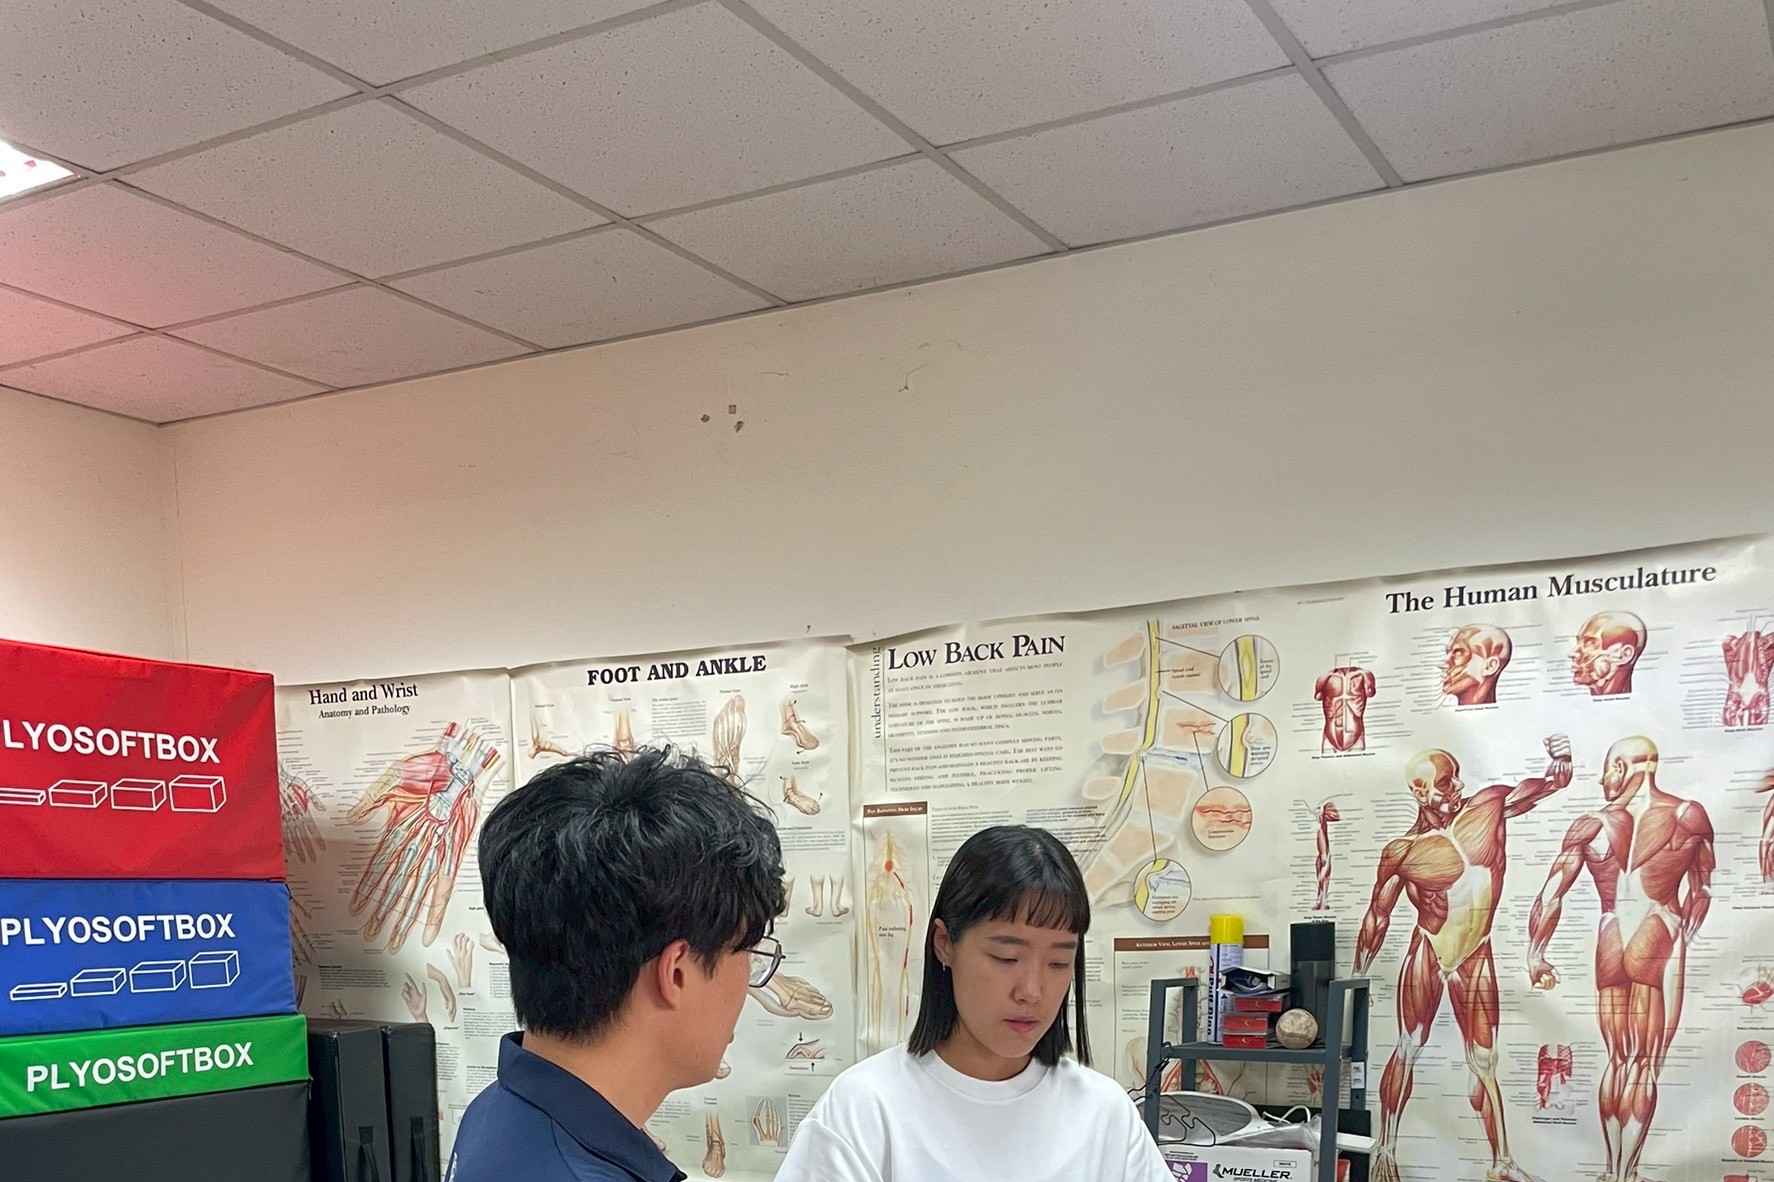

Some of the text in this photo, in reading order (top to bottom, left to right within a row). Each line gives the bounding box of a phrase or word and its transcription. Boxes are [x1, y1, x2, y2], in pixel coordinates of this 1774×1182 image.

[1386, 564, 1717, 614] The Human Musculature
[1171, 622, 1198, 630] SAGITTAL
[888, 634, 1066, 670] LOW BACK PAIN
[587, 655, 767, 686] FOOT AND ANKLE
[308, 682, 418, 705] Hand and Wrist
[870, 646, 882, 739] understanding
[319, 704, 411, 719] Anatomy and Pathology
[2, 719, 220, 764] LYOSOFTBOX
[1, 913, 236, 946] PLYOSOFTBOX
[27, 1042, 254, 1092] PLYOSOFTBOX
[1222, 1167, 1291, 1180] MUELLER
